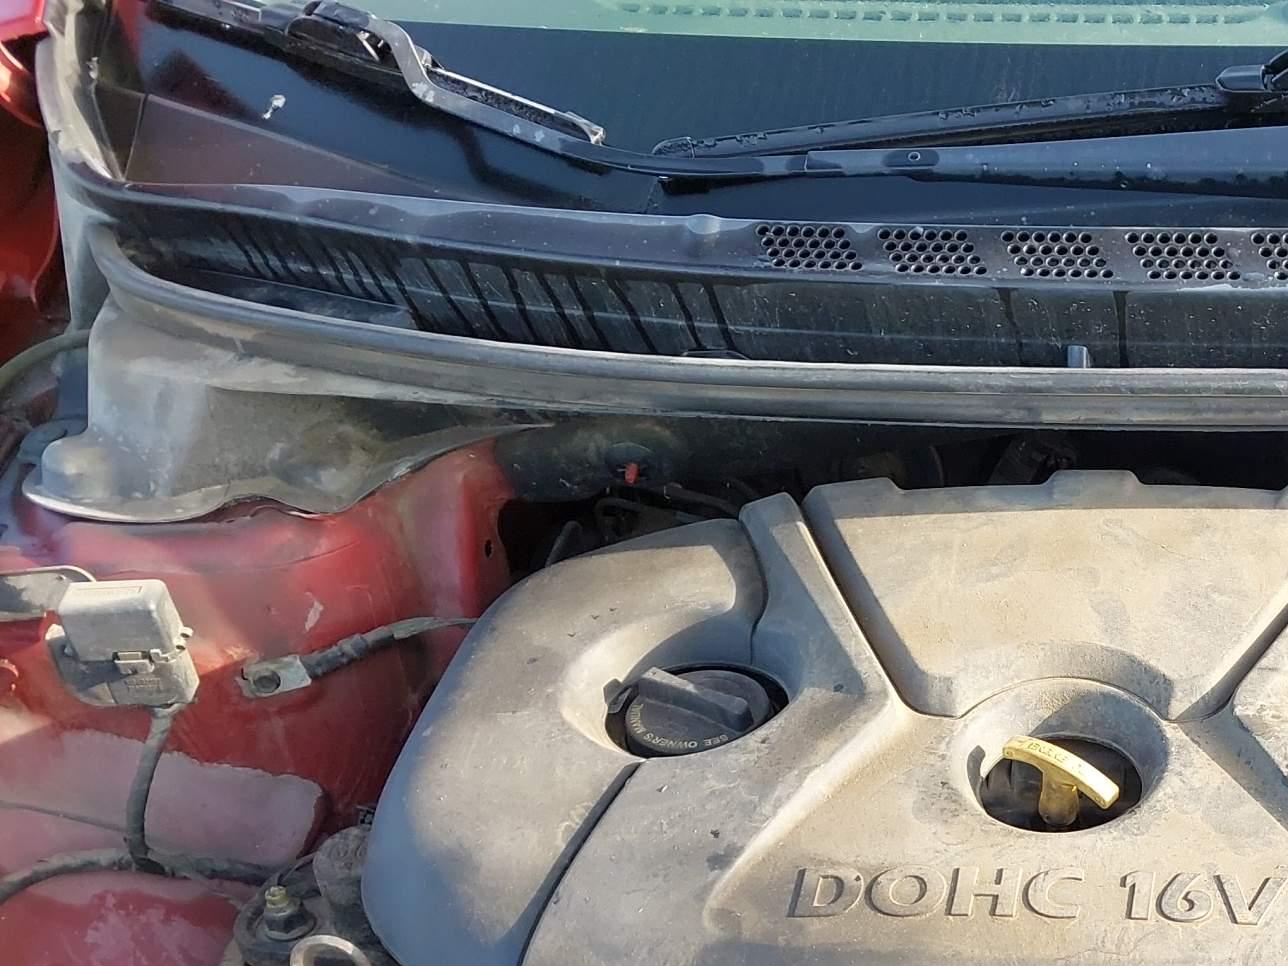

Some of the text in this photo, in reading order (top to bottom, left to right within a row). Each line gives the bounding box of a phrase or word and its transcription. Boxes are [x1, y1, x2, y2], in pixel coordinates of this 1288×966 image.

[644, 732, 698, 750] OWNER'S
[703, 733, 729, 747] SEE
[785, 866, 1086, 920] DOHC
